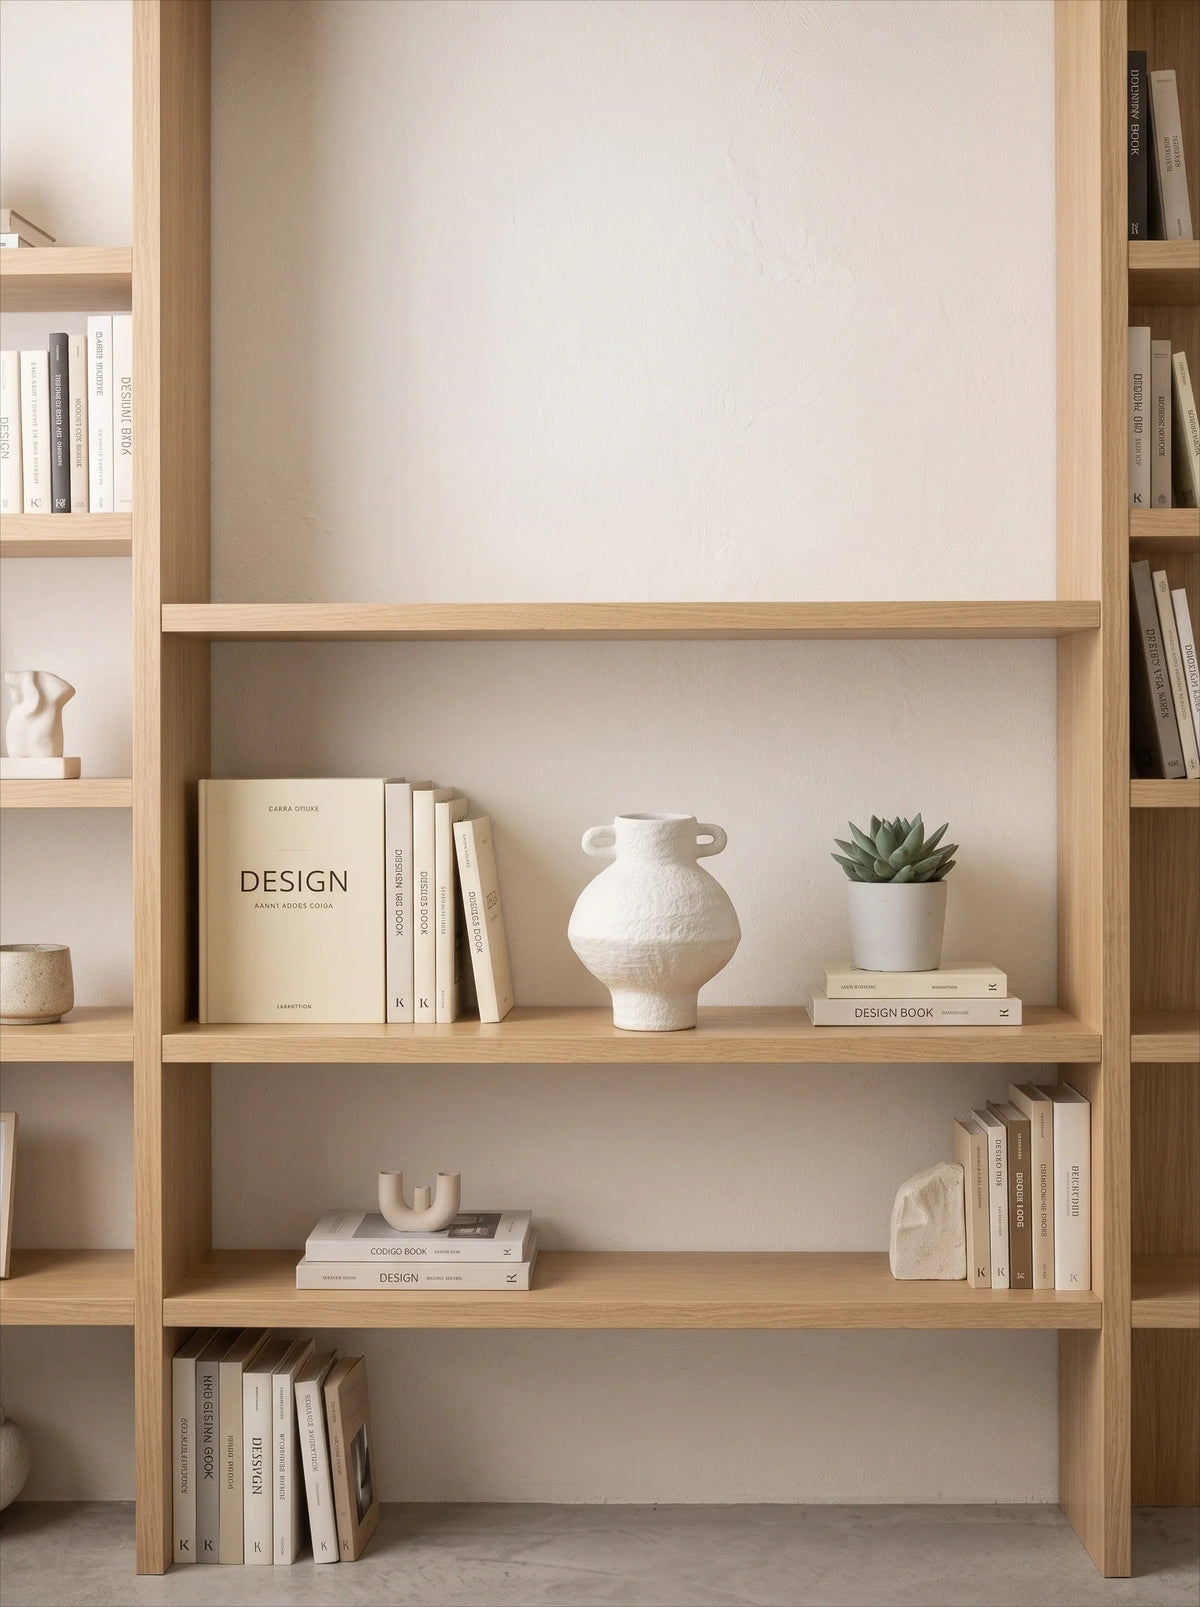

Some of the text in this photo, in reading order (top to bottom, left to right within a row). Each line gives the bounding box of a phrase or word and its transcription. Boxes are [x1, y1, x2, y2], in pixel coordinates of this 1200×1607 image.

[1131, 124, 1139, 156] BOOK
[0, 417, 10, 459] DESIGN
[241, 870, 348, 892] DESIGN
[395, 910, 403, 936] DOOK
[420, 909, 428, 935] DOOK
[473, 928, 483, 954] DOOK
[988, 983, 998, 991] K
[395, 998, 405, 1008] K
[419, 998, 429, 1008] K
[855, 1008, 898, 1018] DESIGN
[900, 1008, 934, 1018] BOOK
[999, 1008, 1009, 1017] K
[371, 1247, 402, 1256] CODIGO
[405, 1247, 427, 1255] BOOK
[977, 1267, 986, 1278] K
[997, 1267, 1006, 1277] K
[379, 1273, 419, 1283] DESIGN
[506, 1273, 518, 1283] K
[179, 1540, 189, 1551] K
[204, 1540, 214, 1551] K
[254, 1541, 262, 1553] K
[320, 1541, 328, 1552] K
[342, 1539, 350, 1550] K
